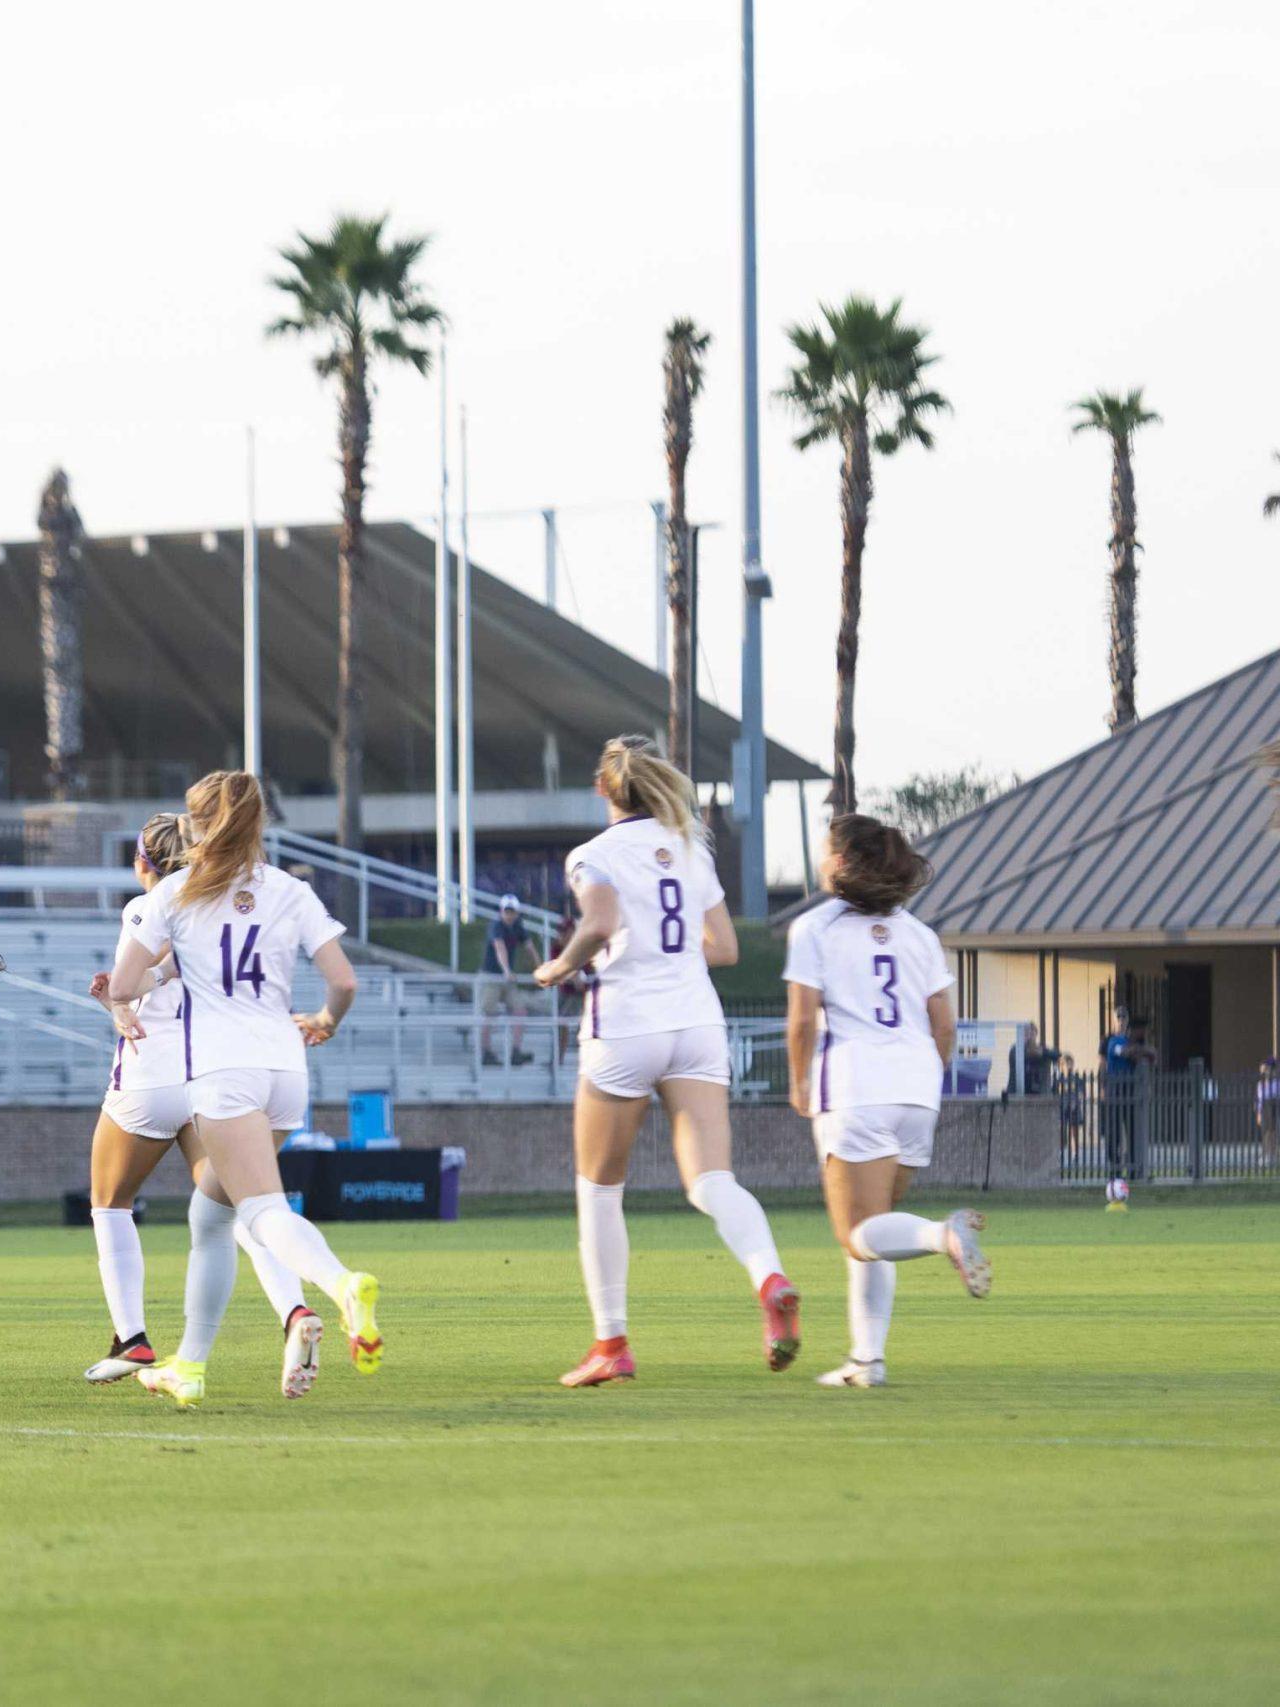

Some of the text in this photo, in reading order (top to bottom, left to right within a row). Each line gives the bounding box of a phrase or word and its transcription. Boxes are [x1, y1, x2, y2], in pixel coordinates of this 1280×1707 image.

[658, 878, 685, 953] 8
[220, 923, 266, 998] 14
[873, 954, 899, 1028] 3
[341, 1182, 425, 1203] POWERADE
